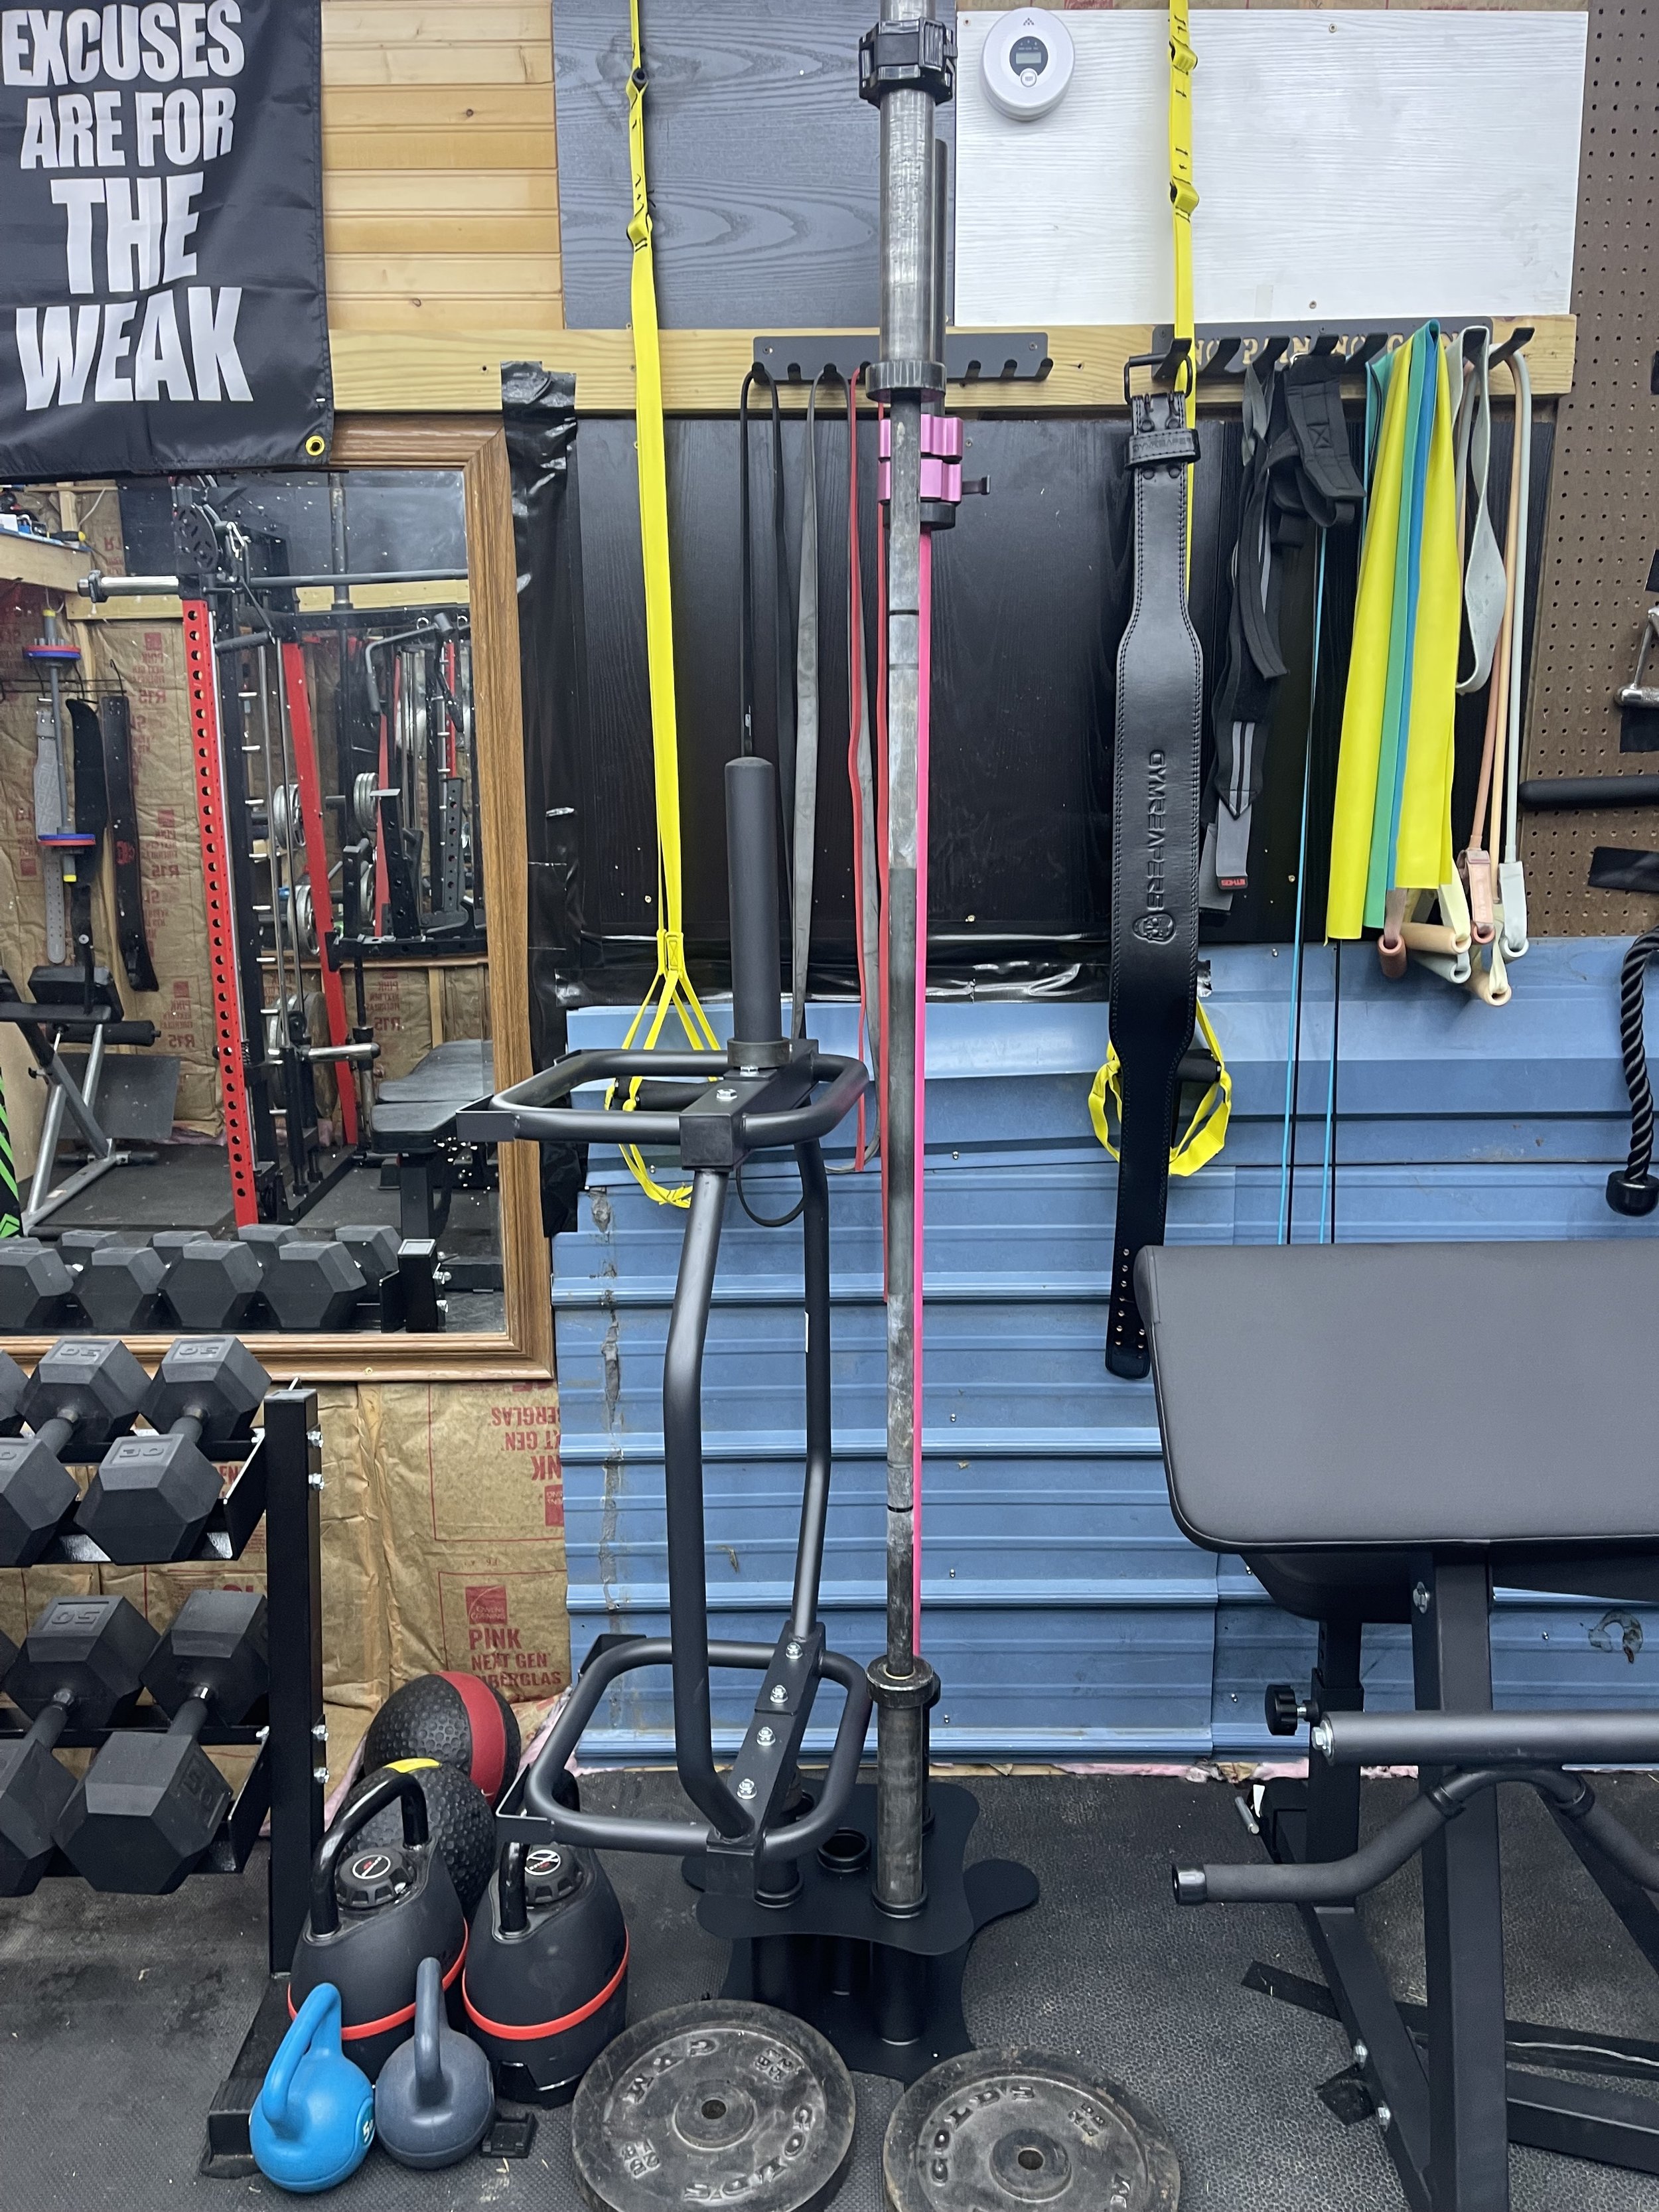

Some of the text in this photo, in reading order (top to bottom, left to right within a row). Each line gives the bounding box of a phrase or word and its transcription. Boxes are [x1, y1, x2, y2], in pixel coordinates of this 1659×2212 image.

[2, 0, 244, 86] EXCUSES
[20, 87, 236, 169] ARE FOR
[50, 171, 204, 295] THE
[15, 287, 253, 411] WEAK
[1147, 749, 1166, 911] GYMREAPERS
[51, 1611, 100, 1625] 50
[469, 1627, 522, 1651] PINK
[471, 1651, 547, 1671] NEXT GEN
[931, 2085, 1036, 2186] GOLD'S
